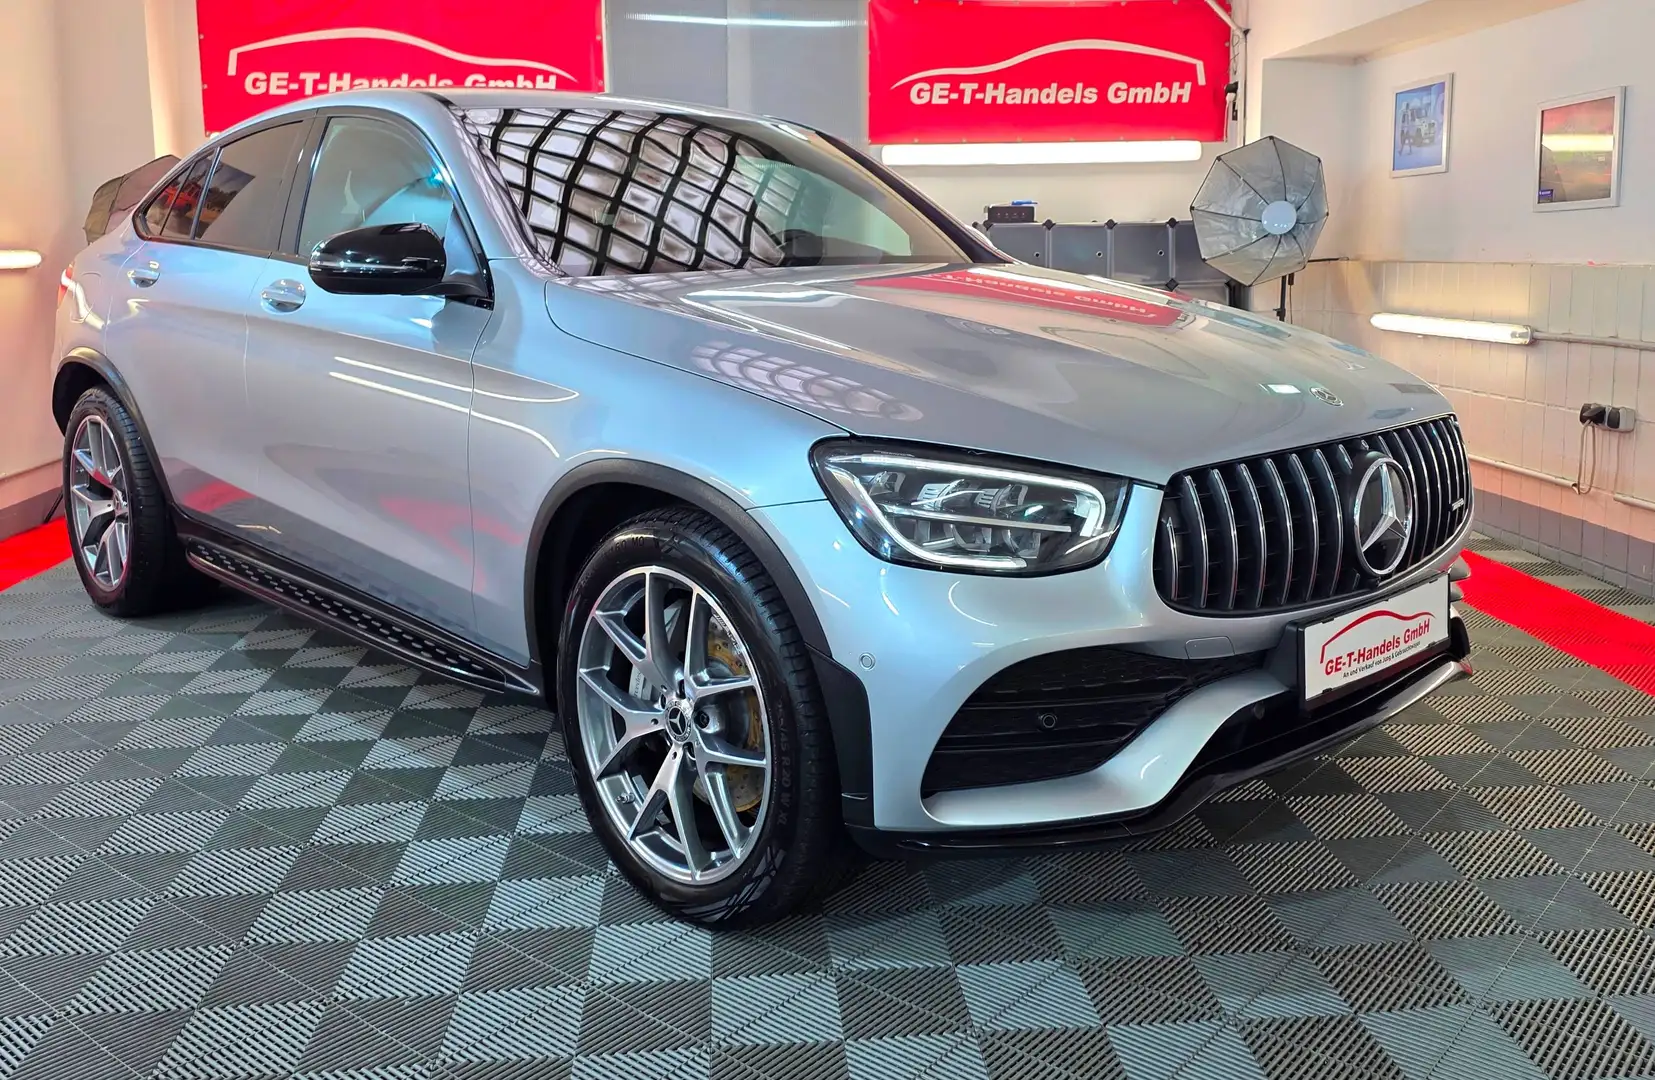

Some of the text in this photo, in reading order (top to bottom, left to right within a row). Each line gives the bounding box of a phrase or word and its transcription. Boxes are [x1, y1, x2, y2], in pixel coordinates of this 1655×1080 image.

[909, 81, 1192, 105] GE-T-Handels GmbH
[1325, 618, 1430, 676] GE-T-Handels GmbH
[1342, 671, 1349, 679] An
[1350, 668, 1358, 676] und
[1358, 660, 1374, 672] Verkauf
